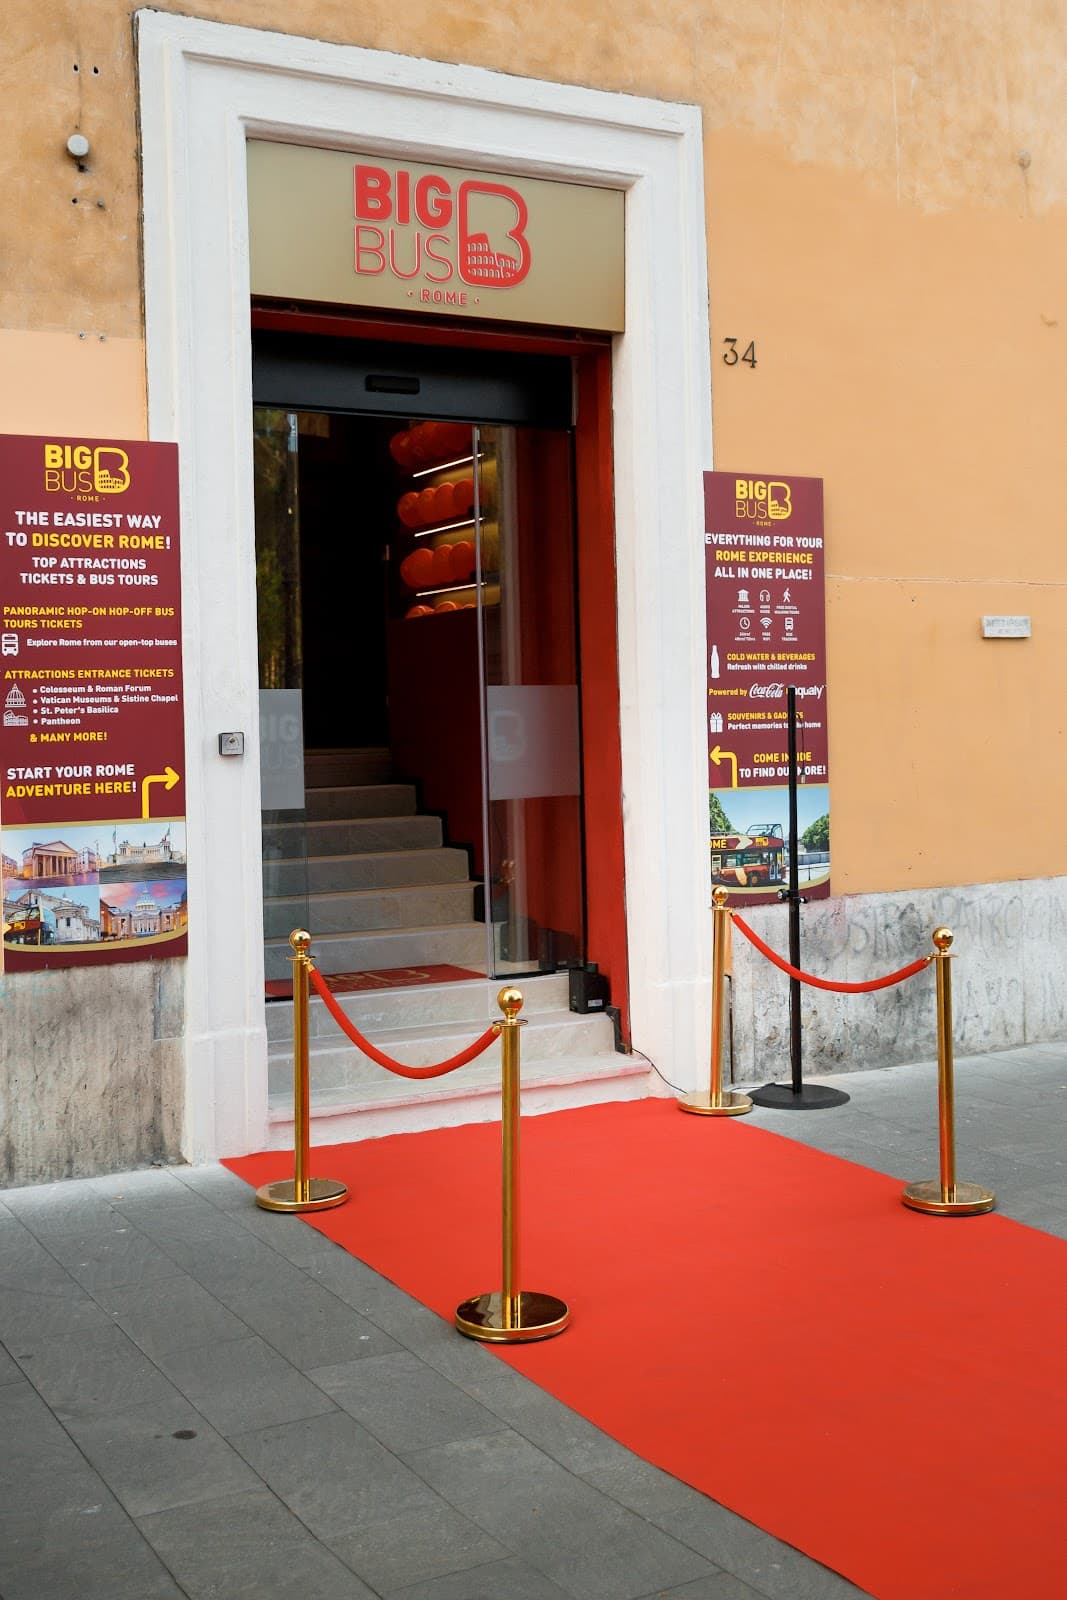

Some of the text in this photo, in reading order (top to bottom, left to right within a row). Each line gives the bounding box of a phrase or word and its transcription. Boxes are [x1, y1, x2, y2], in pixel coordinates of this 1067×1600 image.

[353, 164, 453, 230] BIG
[354, 225, 454, 282] BUS
[421, 289, 468, 305] ROME
[723, 338, 758, 368] 34
[45, 444, 92, 471] BIG
[45, 470, 92, 492] BUS
[736, 480, 767, 501] BIG
[736, 499, 767, 519] BUS
[15, 511, 161, 528] THE EASIEST WAY
[5, 532, 170, 549] TO DISCOVER ROME!
[705, 533, 823, 548] EVERYTHING FOR YOUR
[32, 557, 146, 569] TOP ATTRACTIONS
[716, 550, 813, 564] ROME EXPERIENCE
[20, 573, 158, 585] TICKETS & BUS TOURS
[714, 566, 812, 580] ALL IN ONE PLACE!
[4, 607, 174, 616] PANORAMIC HOP-ON HOP-OFF BUS
[3, 619, 82, 628] TOURS TICKETS
[27, 639, 57, 647] Explore
[119, 639, 154, 647] open-top
[5, 669, 174, 679] ATTRACTIONS ENTRANCE TICKETS
[40, 696, 71, 704] Vatican
[151, 694, 178, 703] Chapel
[740, 688, 747, 696] by
[41, 717, 80, 725] Pantheon
[30, 732, 107, 742] & MANY MORE!
[754, 752, 812, 762] COME INIDE
[7, 764, 134, 780] START YOUR ROME
[739, 769, 751, 777] TO
[754, 768, 775, 777] FIND
[777, 767, 794, 776] OU
[6, 781, 136, 797] ADVENTURE HERE!
